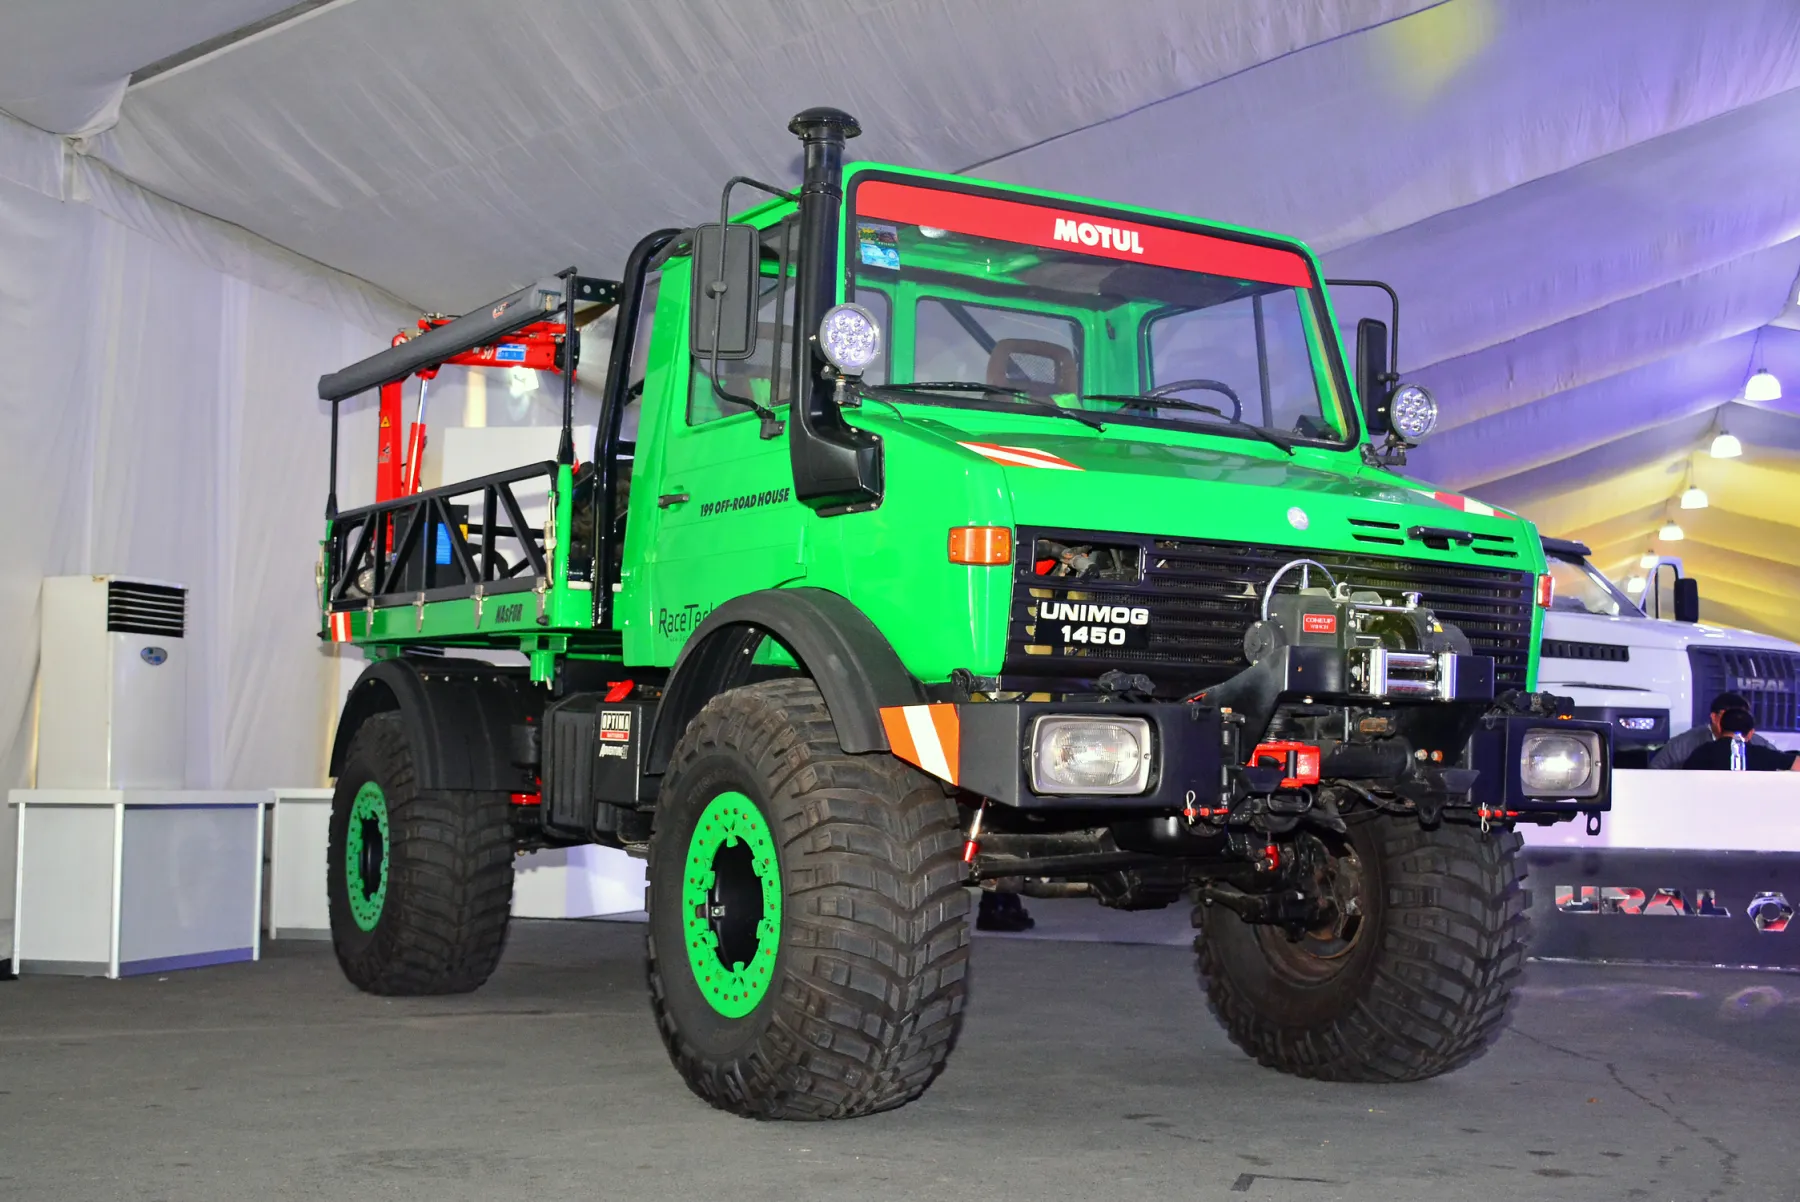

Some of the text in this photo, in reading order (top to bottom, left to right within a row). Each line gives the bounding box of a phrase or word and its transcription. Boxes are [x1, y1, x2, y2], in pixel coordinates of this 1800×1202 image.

[1053, 218, 1144, 254] MOTUL
[700, 487, 790, 517] 199 OFF-ROAD HOUSE
[1040, 601, 1149, 625] UNIMOG
[1061, 625, 1126, 645] 1450
[1737, 677, 1789, 691] URAL
[602, 714, 629, 730] OPTIMA
[1555, 885, 1731, 918] URAL
